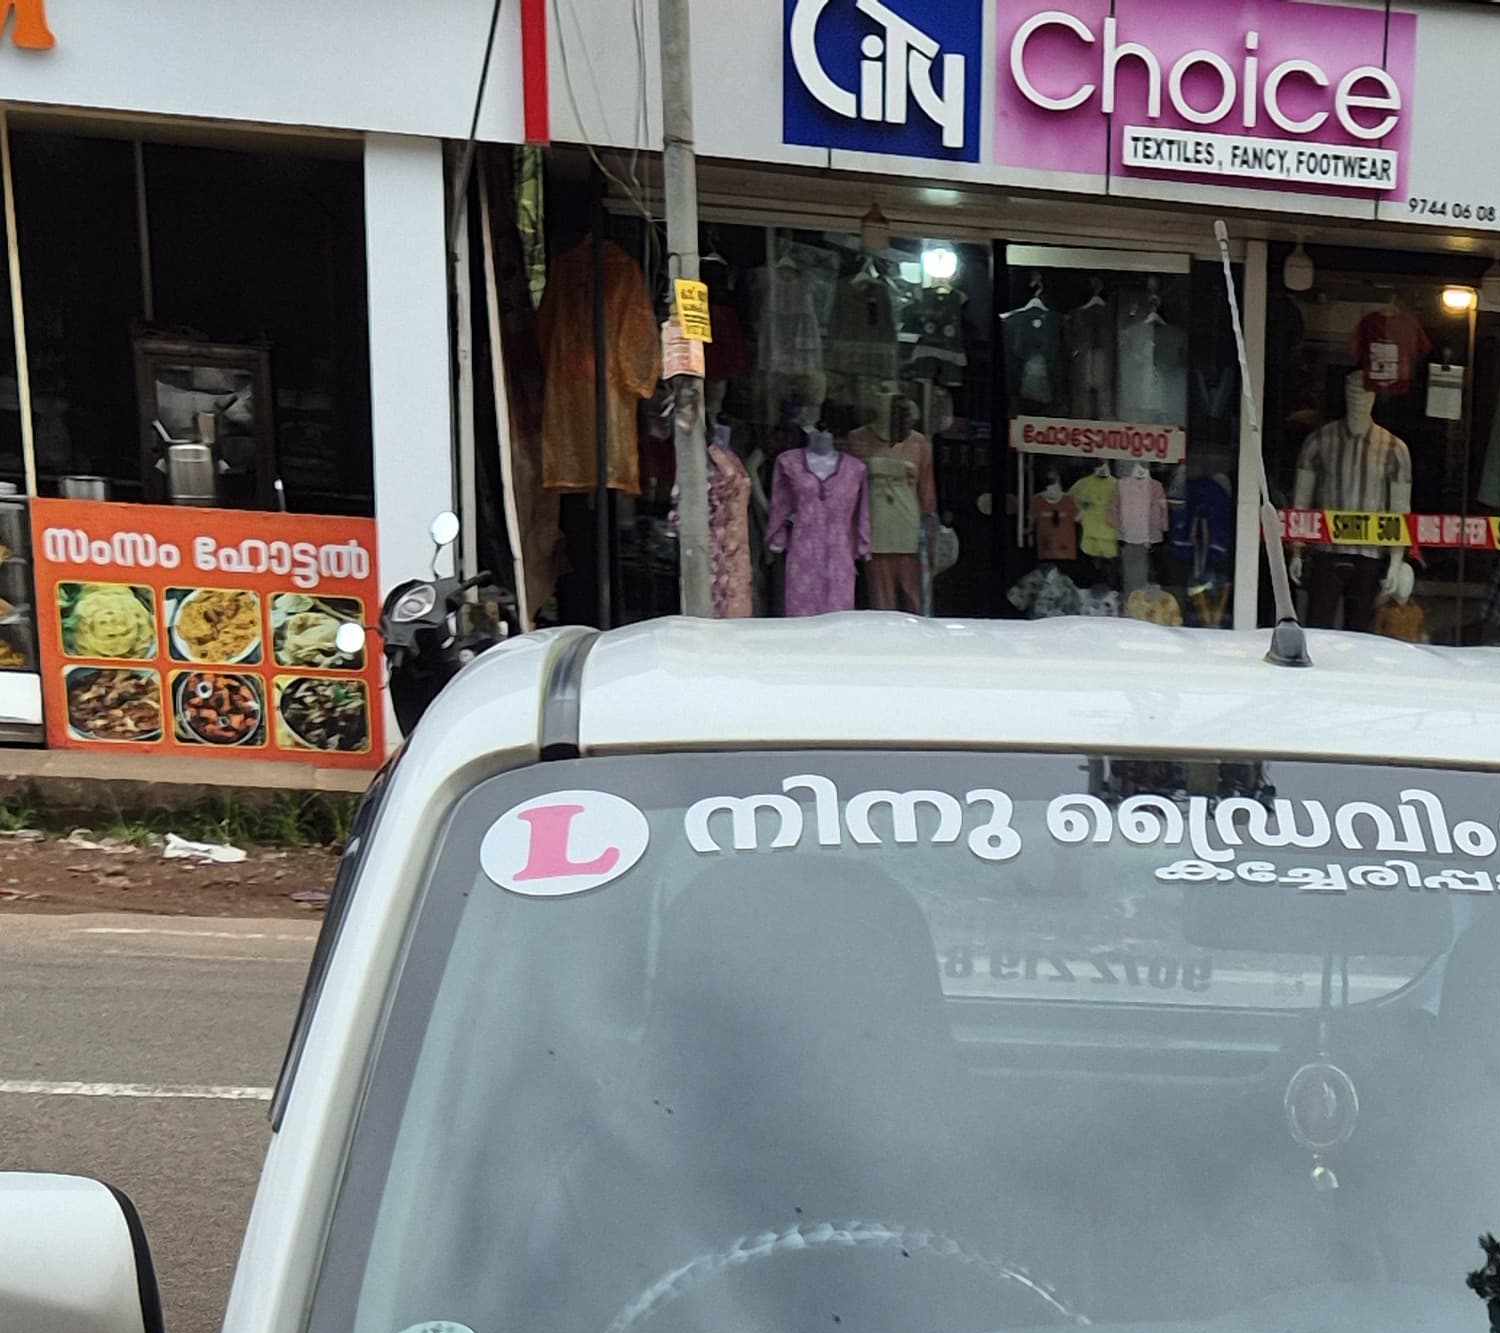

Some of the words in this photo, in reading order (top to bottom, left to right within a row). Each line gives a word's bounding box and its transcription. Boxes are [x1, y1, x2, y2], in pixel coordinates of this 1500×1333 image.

[1010, 11, 1401, 139] Choice
[1231, 146, 1291, 177] FANCY,
[1296, 151, 1393, 182] FOOTWEAR
[1408, 198, 1448, 217] 9744
[1452, 203, 1473, 220] 06
[1477, 205, 1496, 222] 08
[42, 527, 181, 568] സംസം
[192, 535, 371, 588] ഹോട്ടൽ
[1288, 511, 1323, 540] SALE
[1333, 514, 1370, 541] SHIRT
[1377, 515, 1401, 542] 500
[1417, 514, 1441, 543] BIG
[512, 803, 621, 882] L
[684, 774, 1022, 861] നിനു
